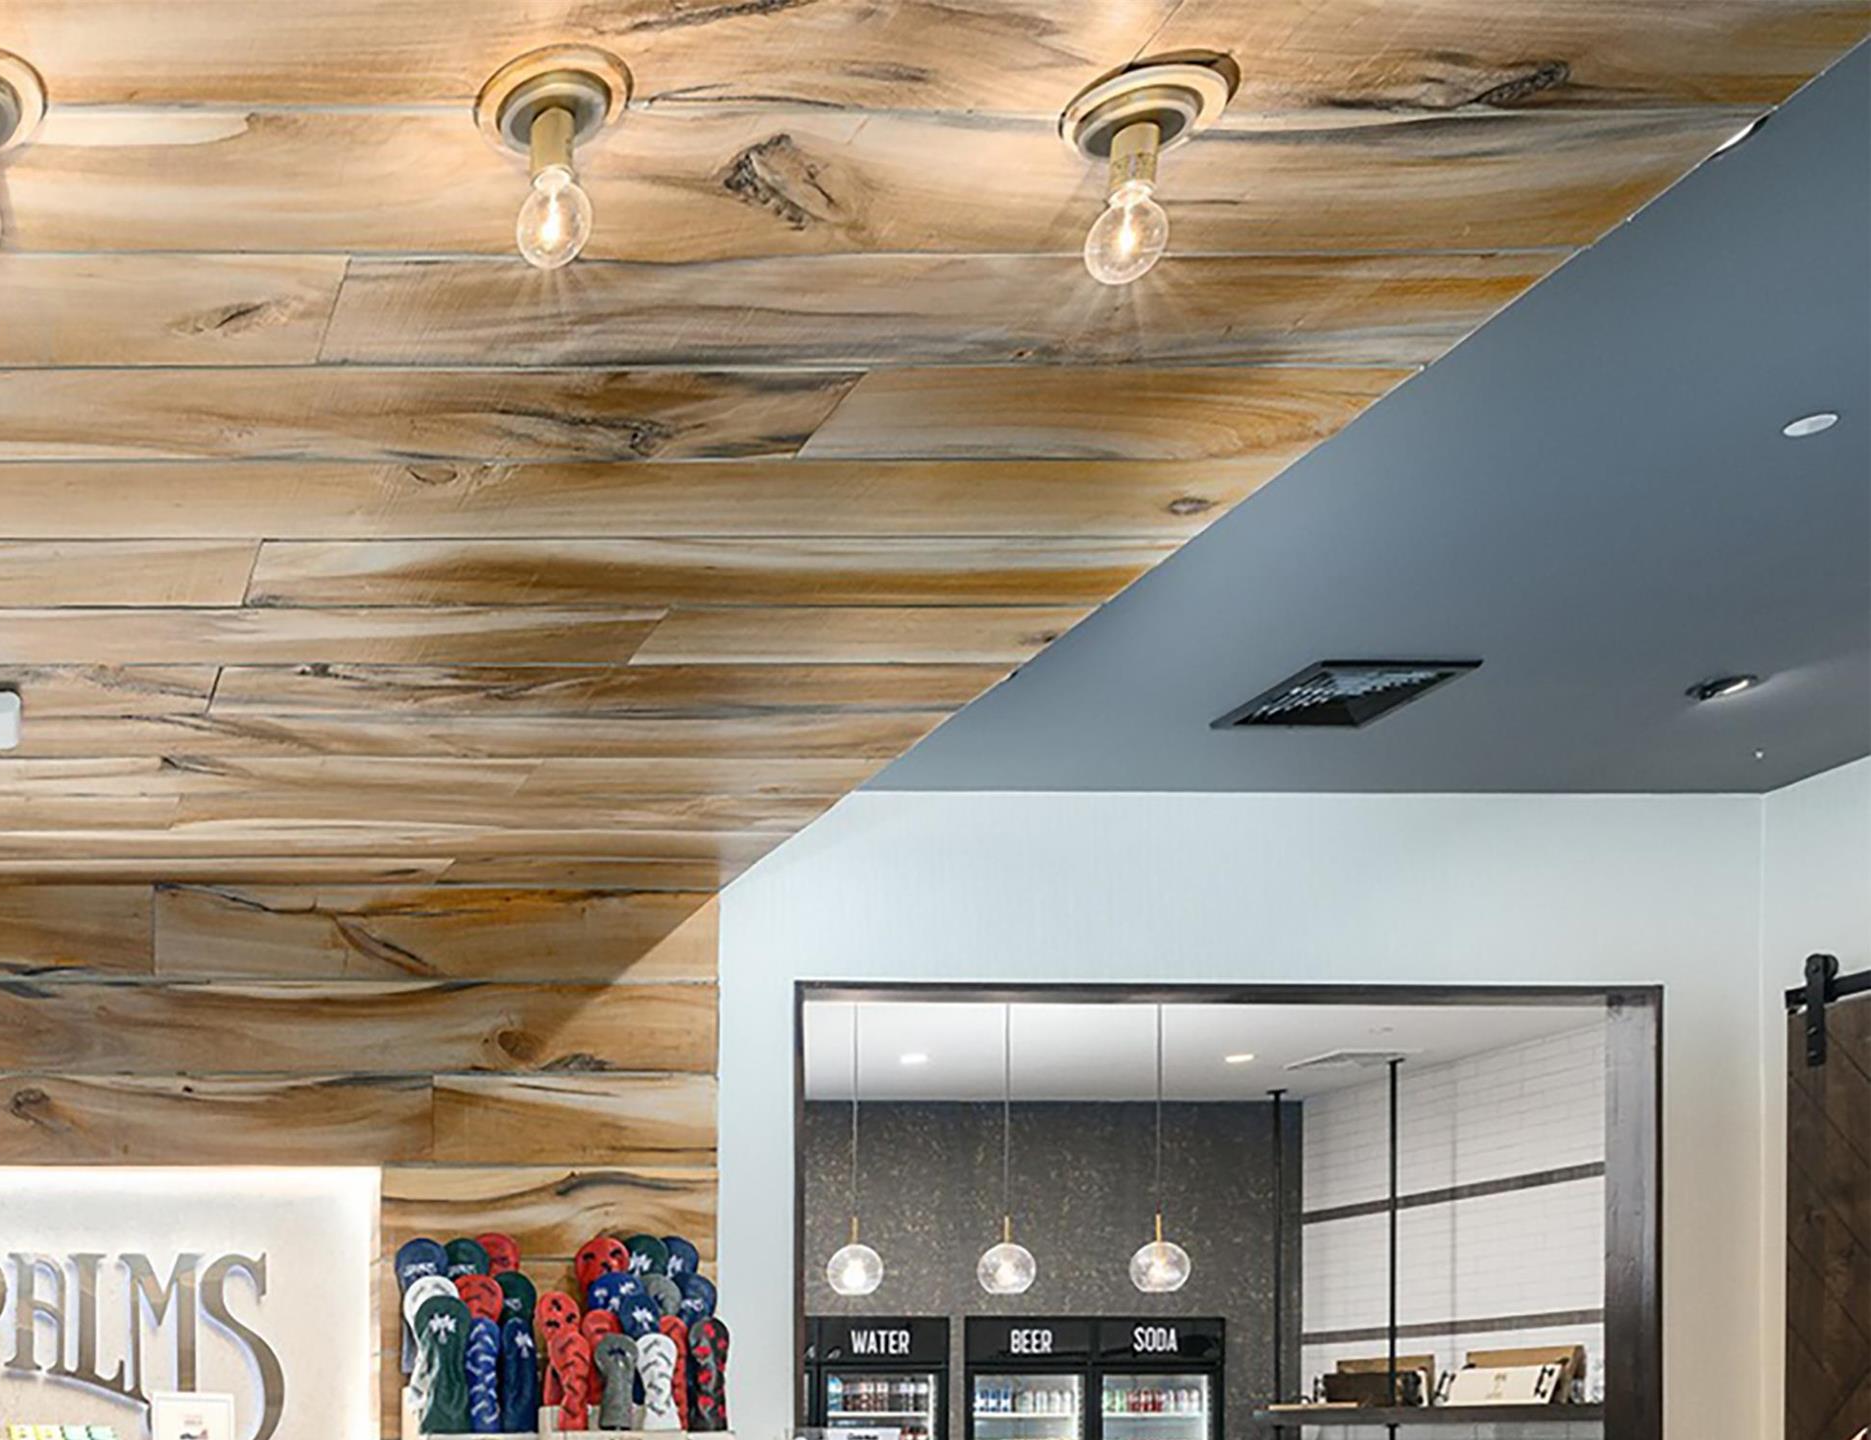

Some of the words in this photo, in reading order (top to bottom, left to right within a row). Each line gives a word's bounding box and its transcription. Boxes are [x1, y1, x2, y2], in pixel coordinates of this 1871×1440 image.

[851, 1330, 910, 1354] WATER
[1010, 1329, 1052, 1353] BEER
[1133, 1327, 1178, 1352] SODA
